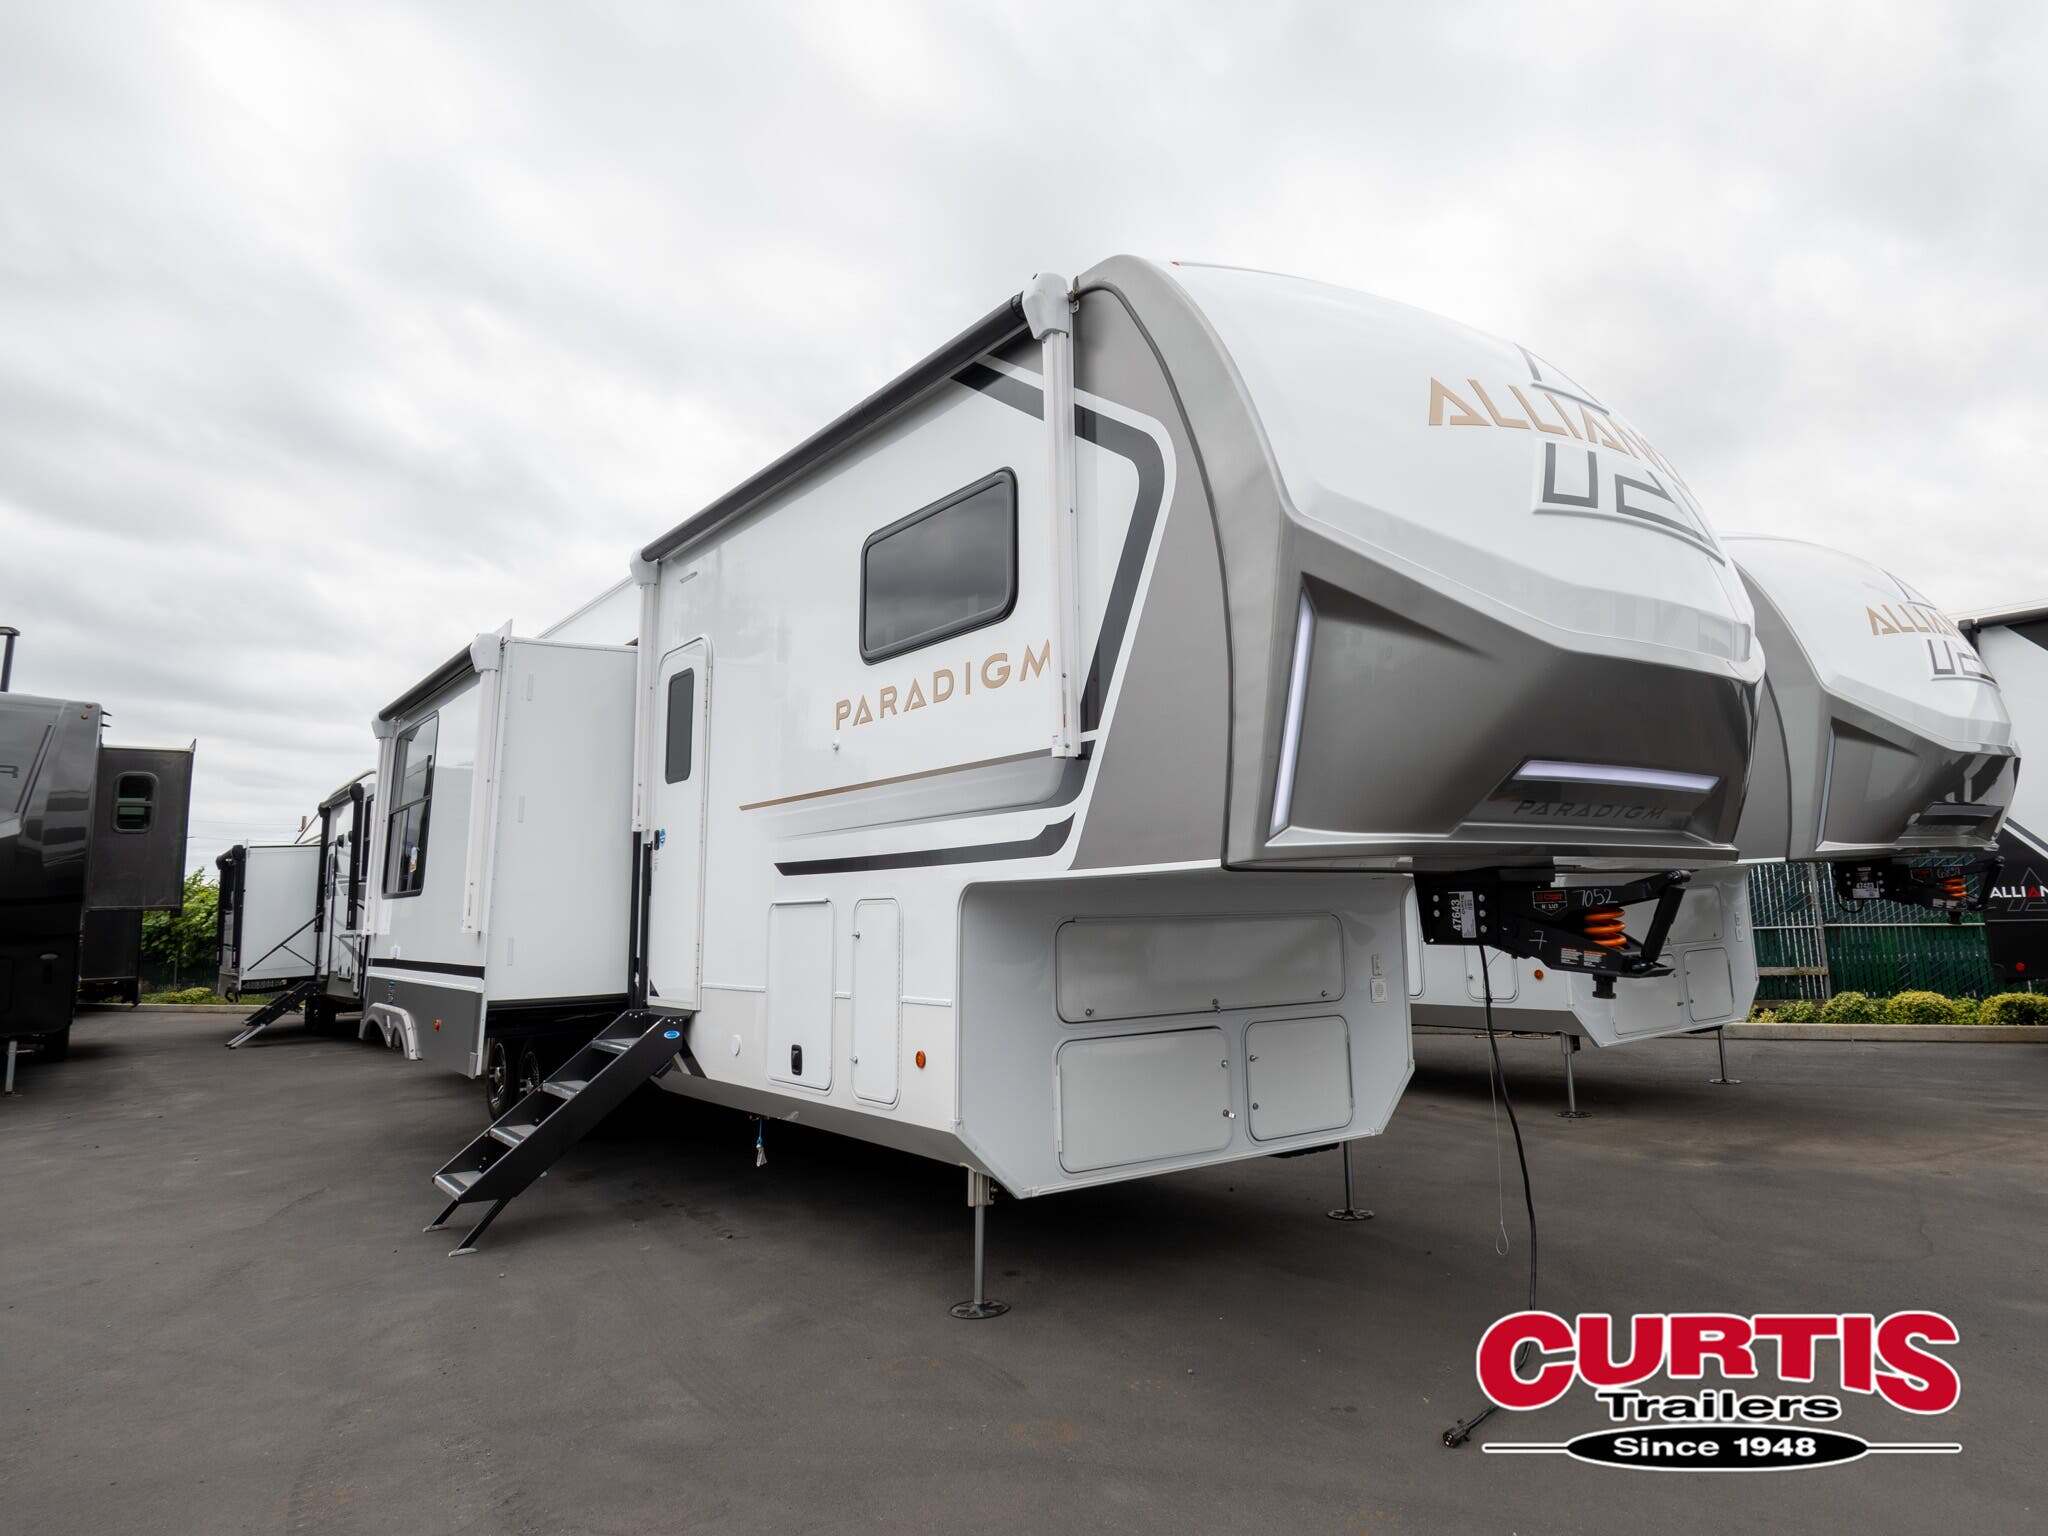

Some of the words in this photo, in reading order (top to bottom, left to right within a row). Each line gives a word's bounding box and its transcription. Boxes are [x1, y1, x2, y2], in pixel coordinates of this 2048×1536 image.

[835, 639, 1051, 730] PARADIGM
[1513, 800, 1668, 820] PARADIGM
[1574, 888, 1619, 907] 7052
[1450, 898, 1462, 931] 47643
